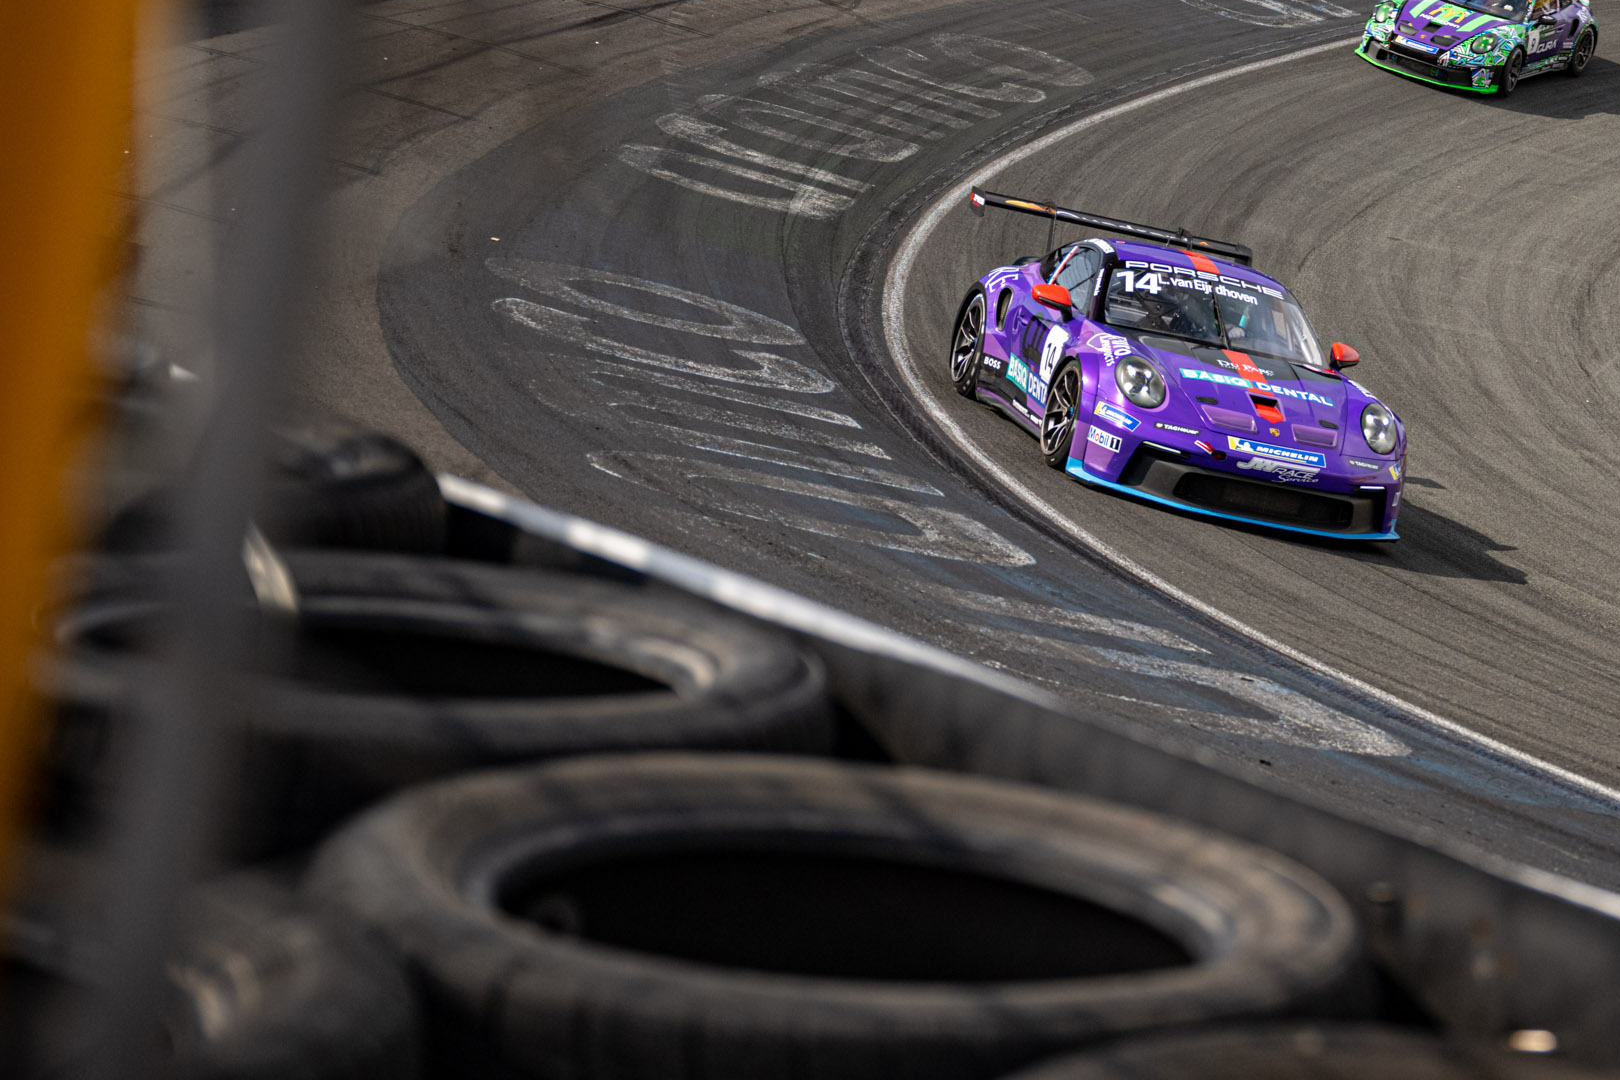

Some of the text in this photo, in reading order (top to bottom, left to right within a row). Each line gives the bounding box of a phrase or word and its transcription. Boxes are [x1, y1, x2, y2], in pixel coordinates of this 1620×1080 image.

[1116, 271, 1162, 295] 14
[1125, 260, 1284, 300] PORSCHE
[1158, 273, 1170, 285] L.
[1169, 276, 1194, 290] van
[983, 356, 1002, 370] BOSS
[1044, 342, 1057, 375] 14
[1007, 356, 1028, 390] BASIQ
[1182, 369, 1250, 388] BASIQ
[1255, 382, 1334, 407] DENTAL
[1088, 428, 1109, 447] Mobil
[1256, 445, 1319, 463] MICHELIN
[1273, 468, 1316, 479] RACE
